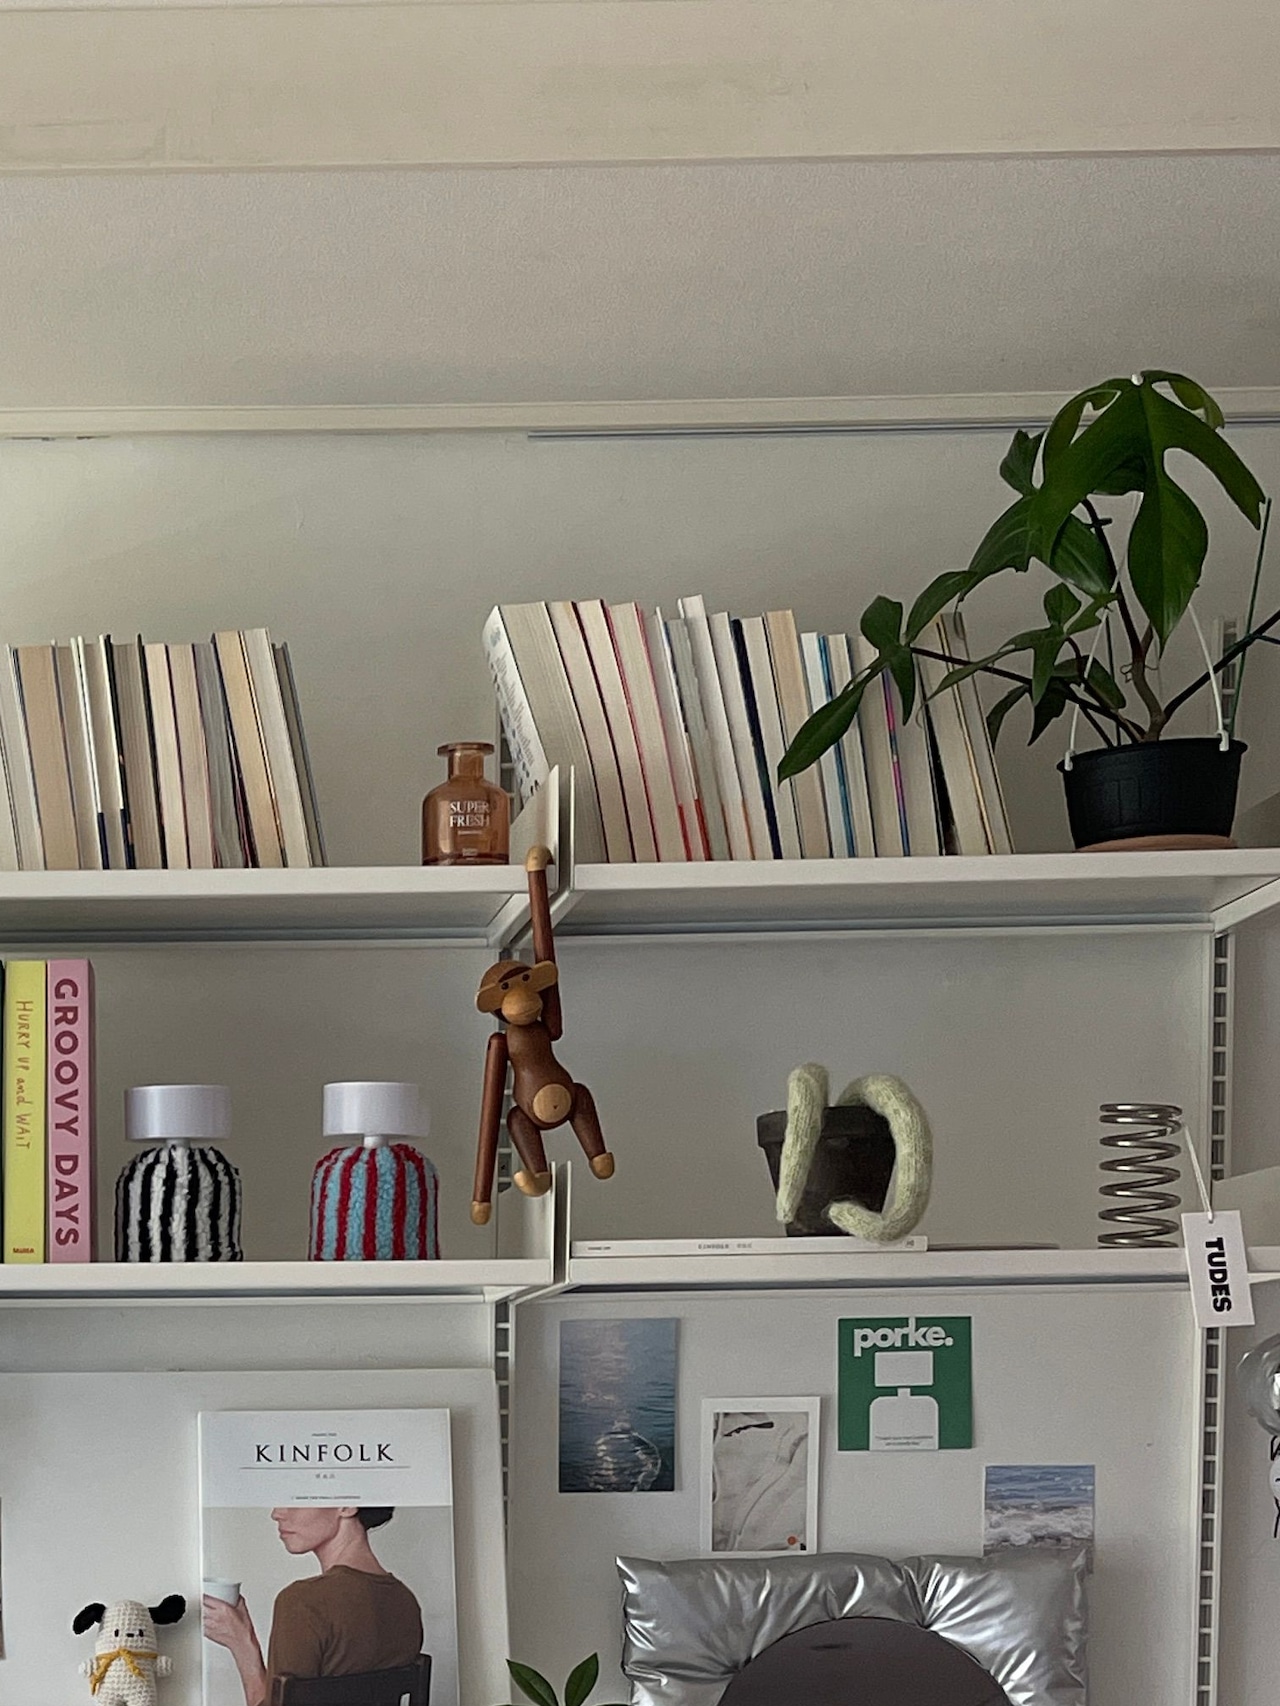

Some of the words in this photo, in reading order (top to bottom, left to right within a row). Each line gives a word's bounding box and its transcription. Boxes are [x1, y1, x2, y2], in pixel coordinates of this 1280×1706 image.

[449, 815, 490, 828] FRESH
[450, 801, 489, 814] SUPER
[54, 978, 80, 1137] GROOVY
[16, 1077, 34, 1107] and
[55, 1154, 80, 1247] DAYS
[1205, 1236, 1233, 1313] TUDES
[853, 1316, 954, 1357] porke.
[255, 1442, 395, 1463] KINFOLK
